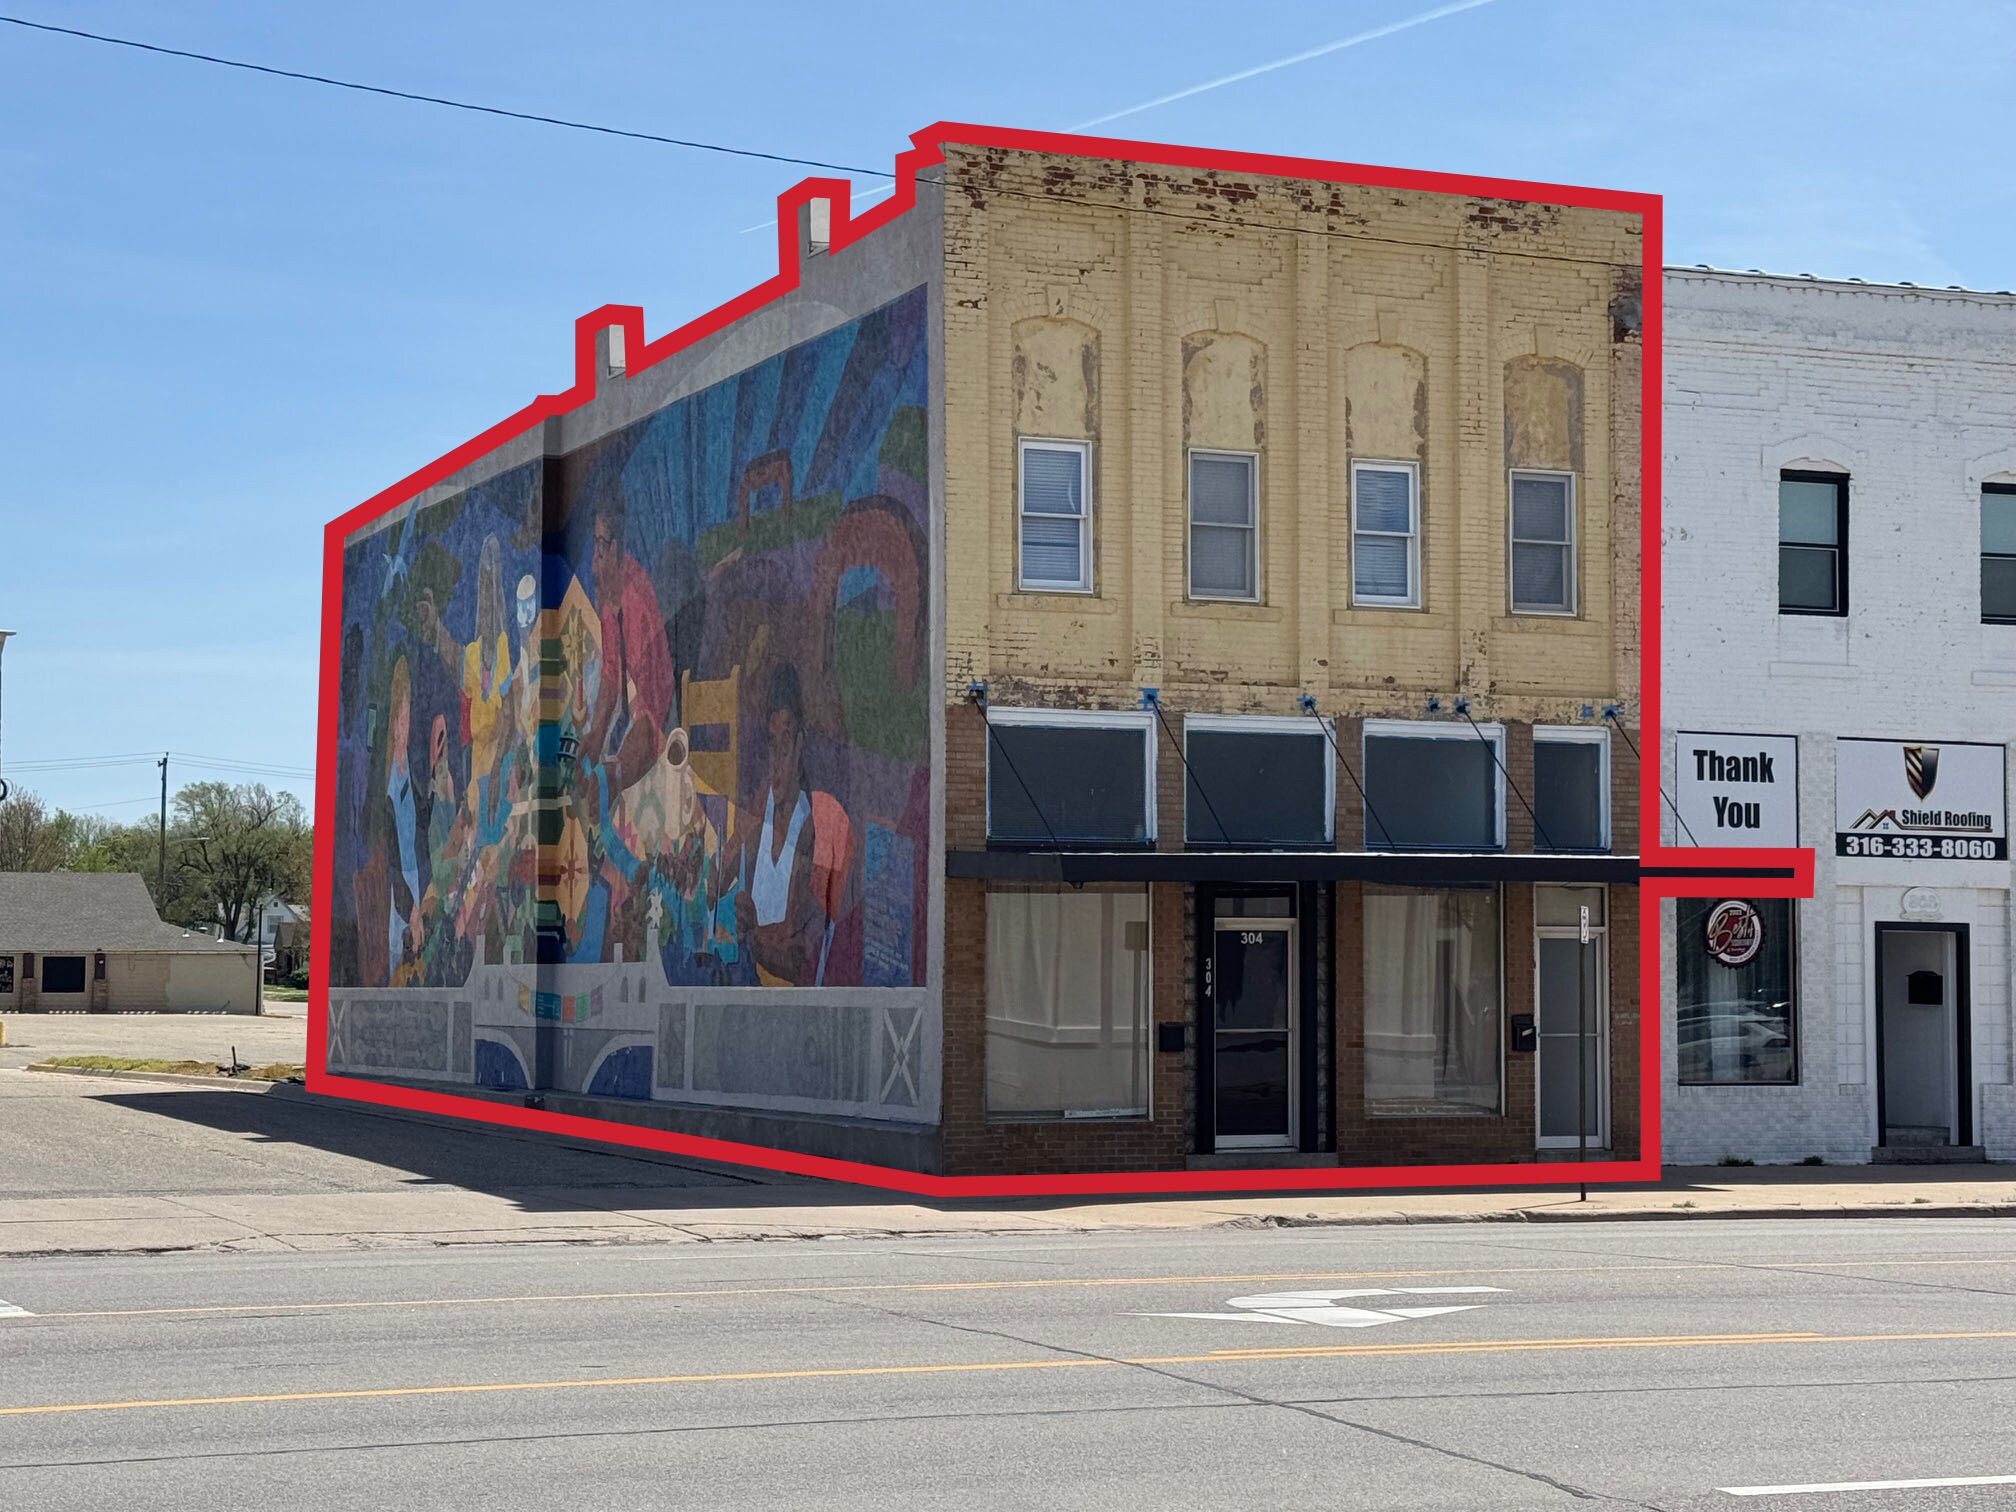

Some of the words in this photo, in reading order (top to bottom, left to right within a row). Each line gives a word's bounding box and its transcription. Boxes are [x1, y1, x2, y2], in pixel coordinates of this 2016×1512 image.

[1693, 749, 1775, 783] Thank
[1712, 796, 1760, 828] You
[1902, 809, 1942, 826] Shield
[1945, 812, 1992, 829] Roofing
[1846, 836, 1996, 859] 316-333-8060
[1240, 932, 1263, 944] 304
